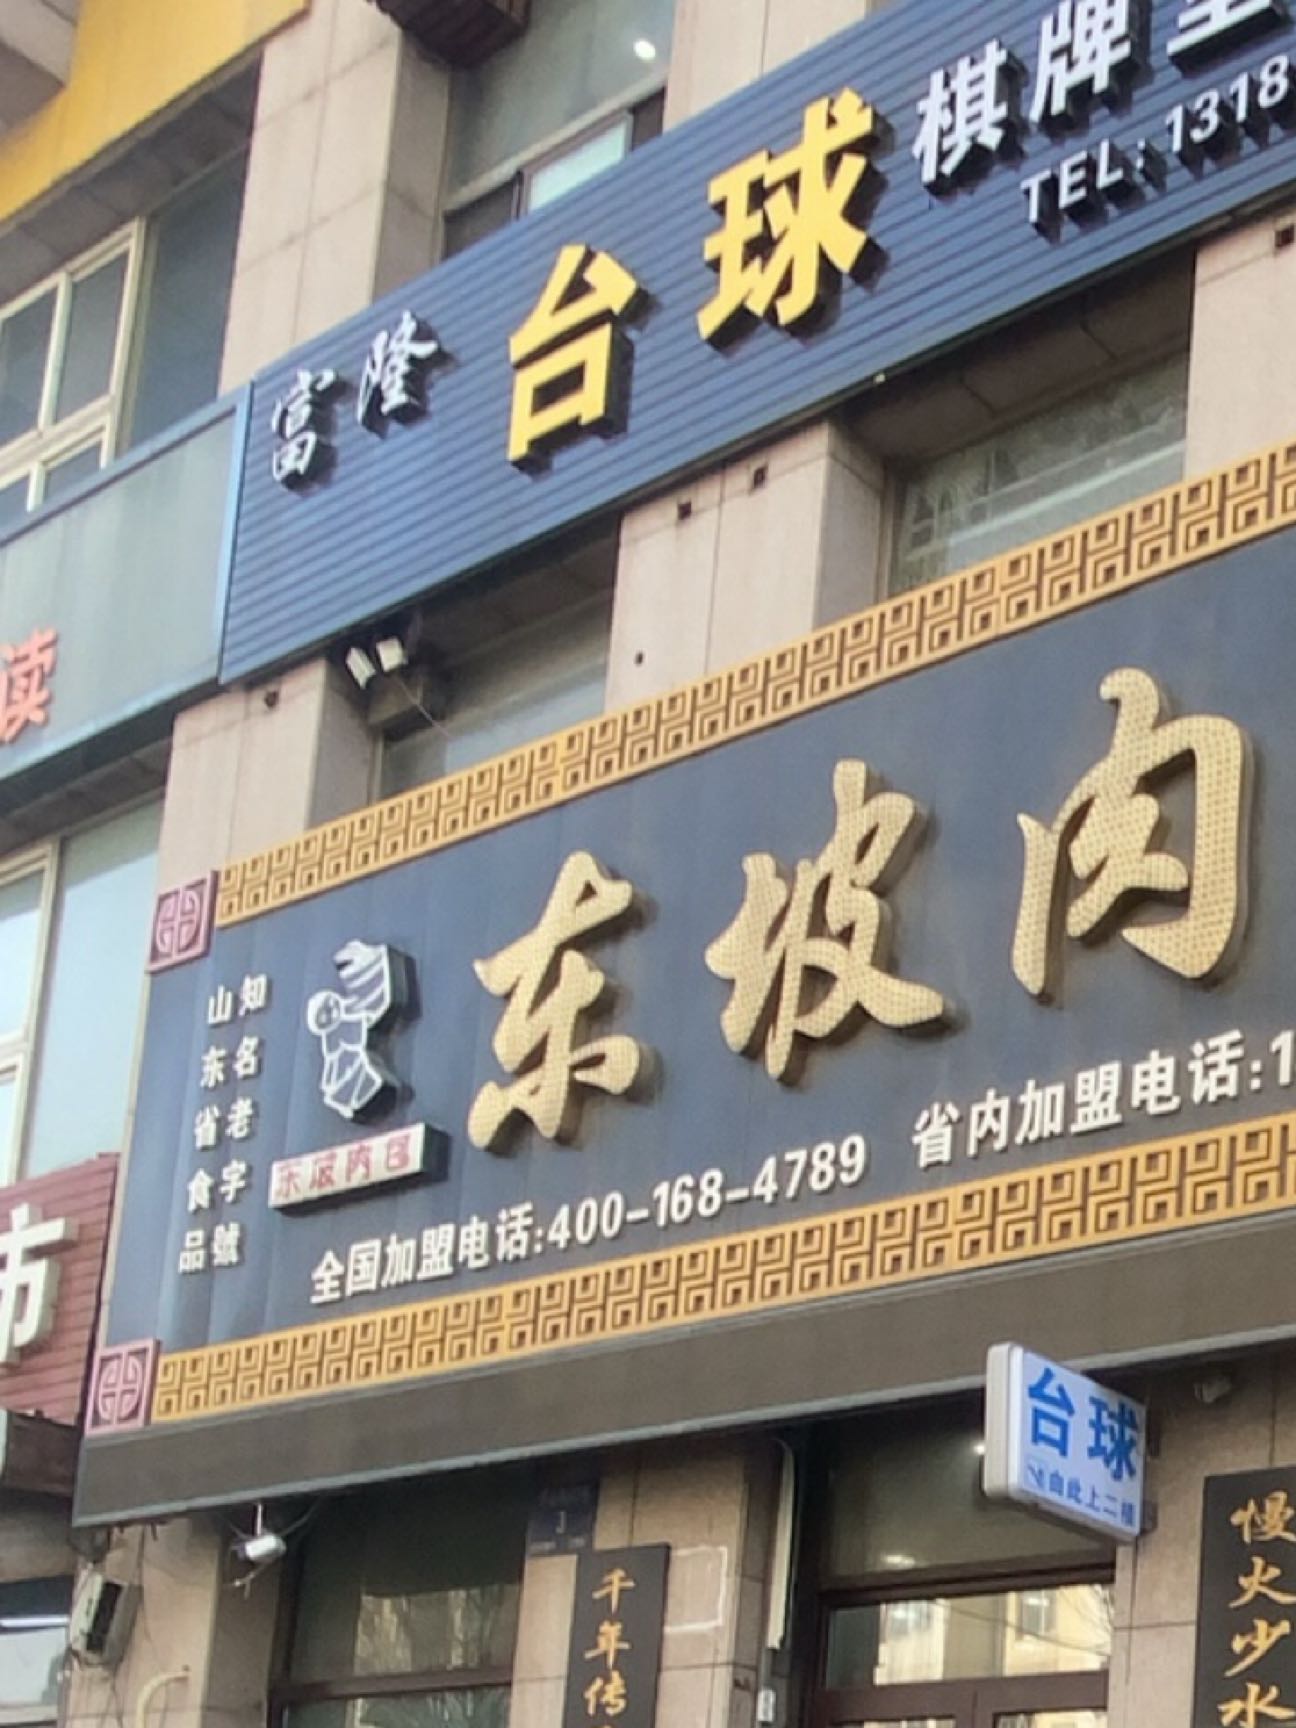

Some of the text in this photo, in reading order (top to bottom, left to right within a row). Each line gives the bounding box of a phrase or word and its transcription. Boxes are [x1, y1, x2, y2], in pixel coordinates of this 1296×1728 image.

[506, 87, 875, 463] 台球
[0, 1202, 67, 1364] 市
[1027, 1366, 1139, 1482] 台球
